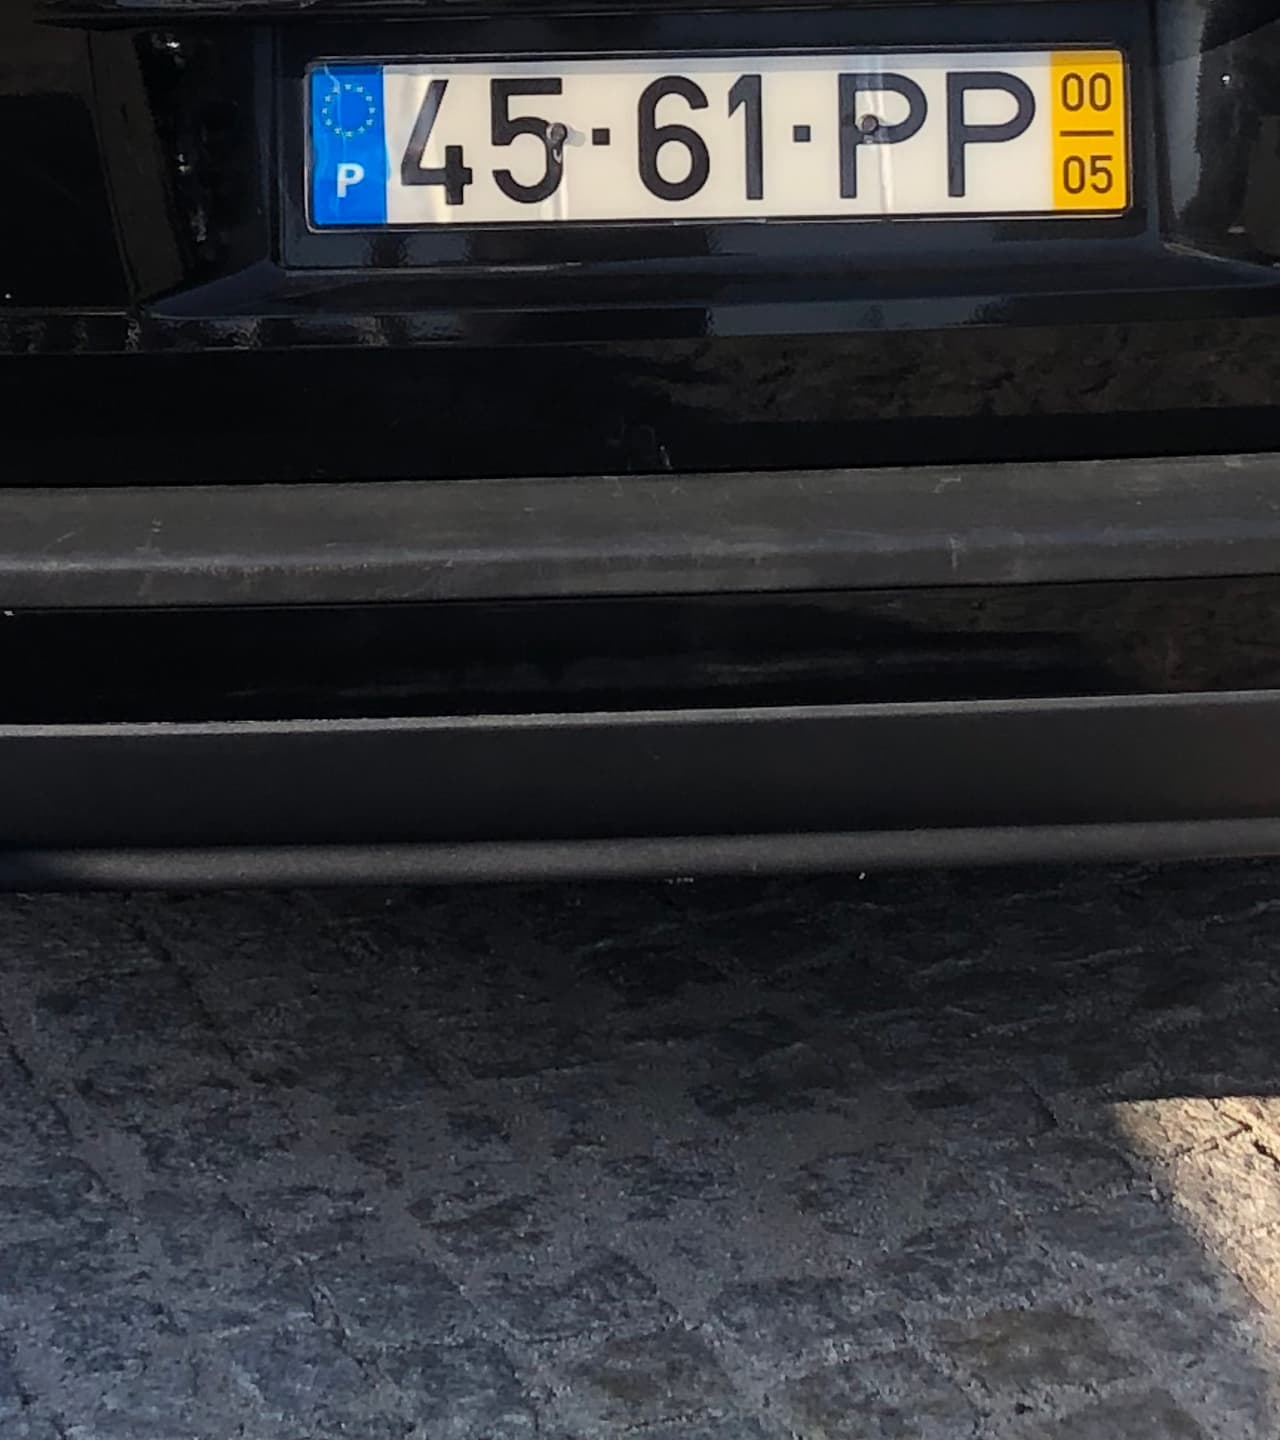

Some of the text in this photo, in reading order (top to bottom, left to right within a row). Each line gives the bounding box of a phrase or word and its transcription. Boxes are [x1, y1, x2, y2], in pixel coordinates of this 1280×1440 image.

[1061, 72, 1112, 111] 00
[336, 163, 365, 198] P
[1063, 155, 1113, 194] 05
